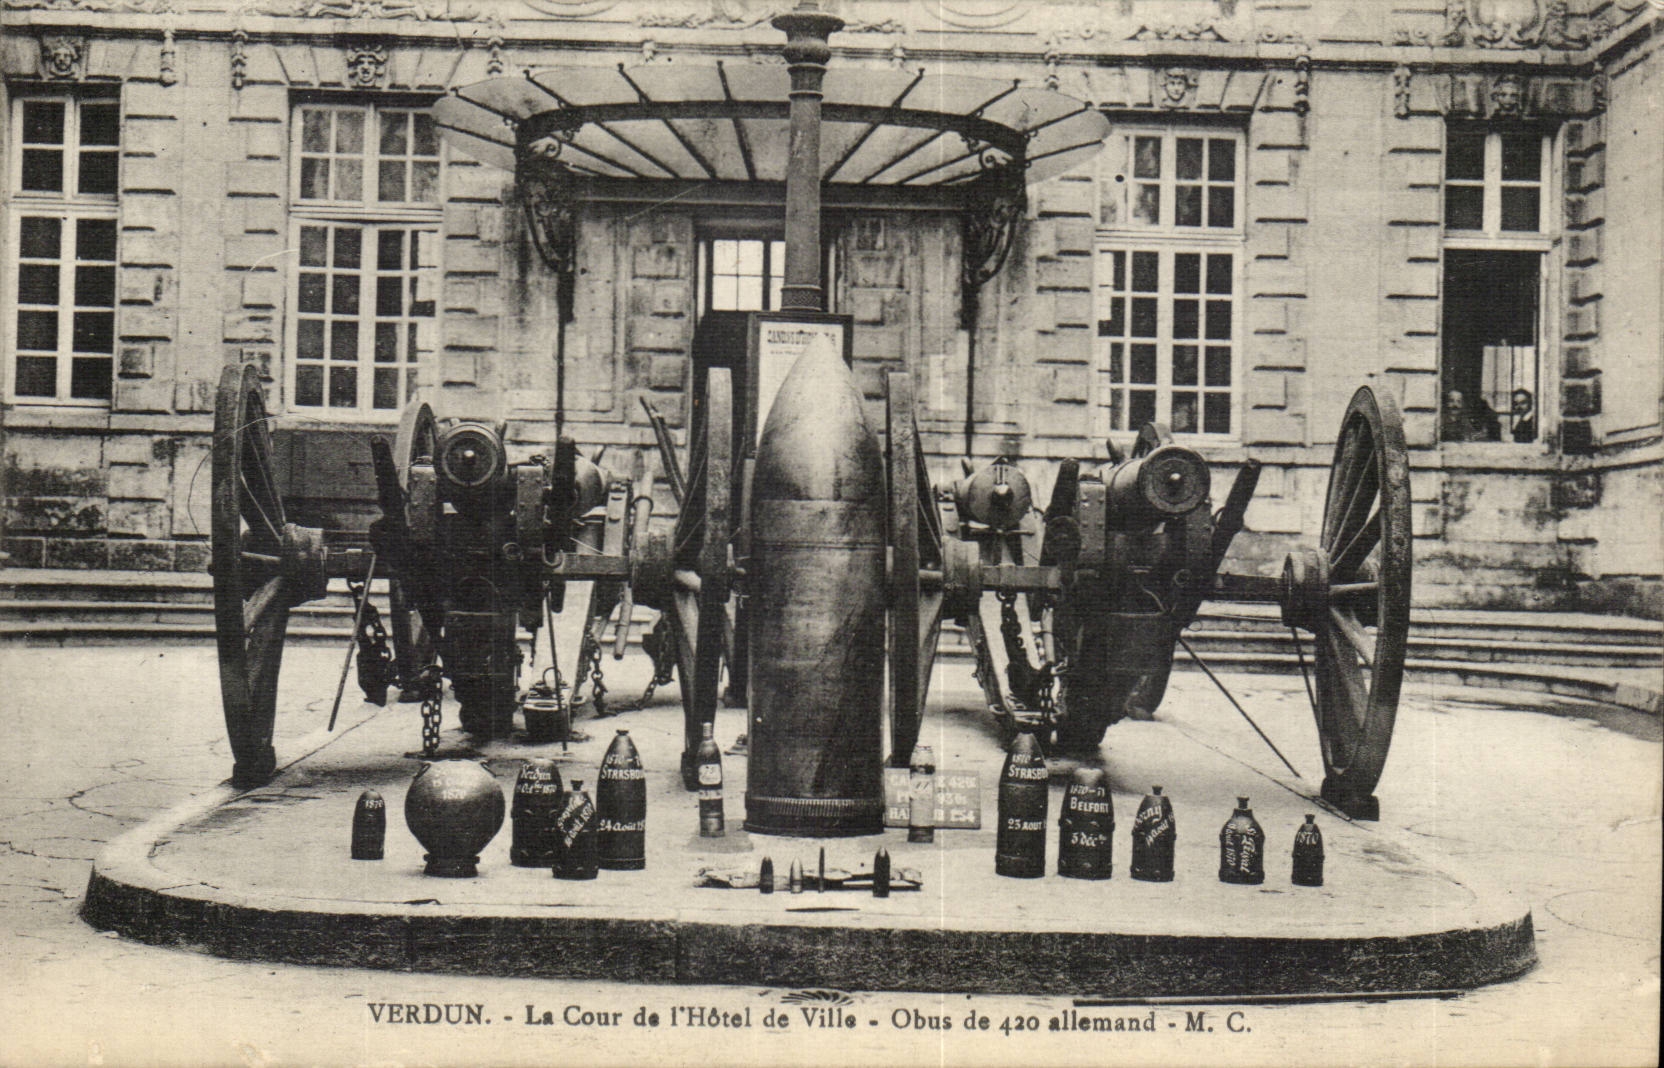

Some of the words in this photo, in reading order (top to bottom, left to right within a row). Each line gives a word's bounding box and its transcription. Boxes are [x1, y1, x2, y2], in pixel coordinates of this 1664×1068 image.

[364, 799, 383, 809] 1870
[1070, 797, 1109, 814] BELFORT
[1297, 830, 1320, 846] 1870
